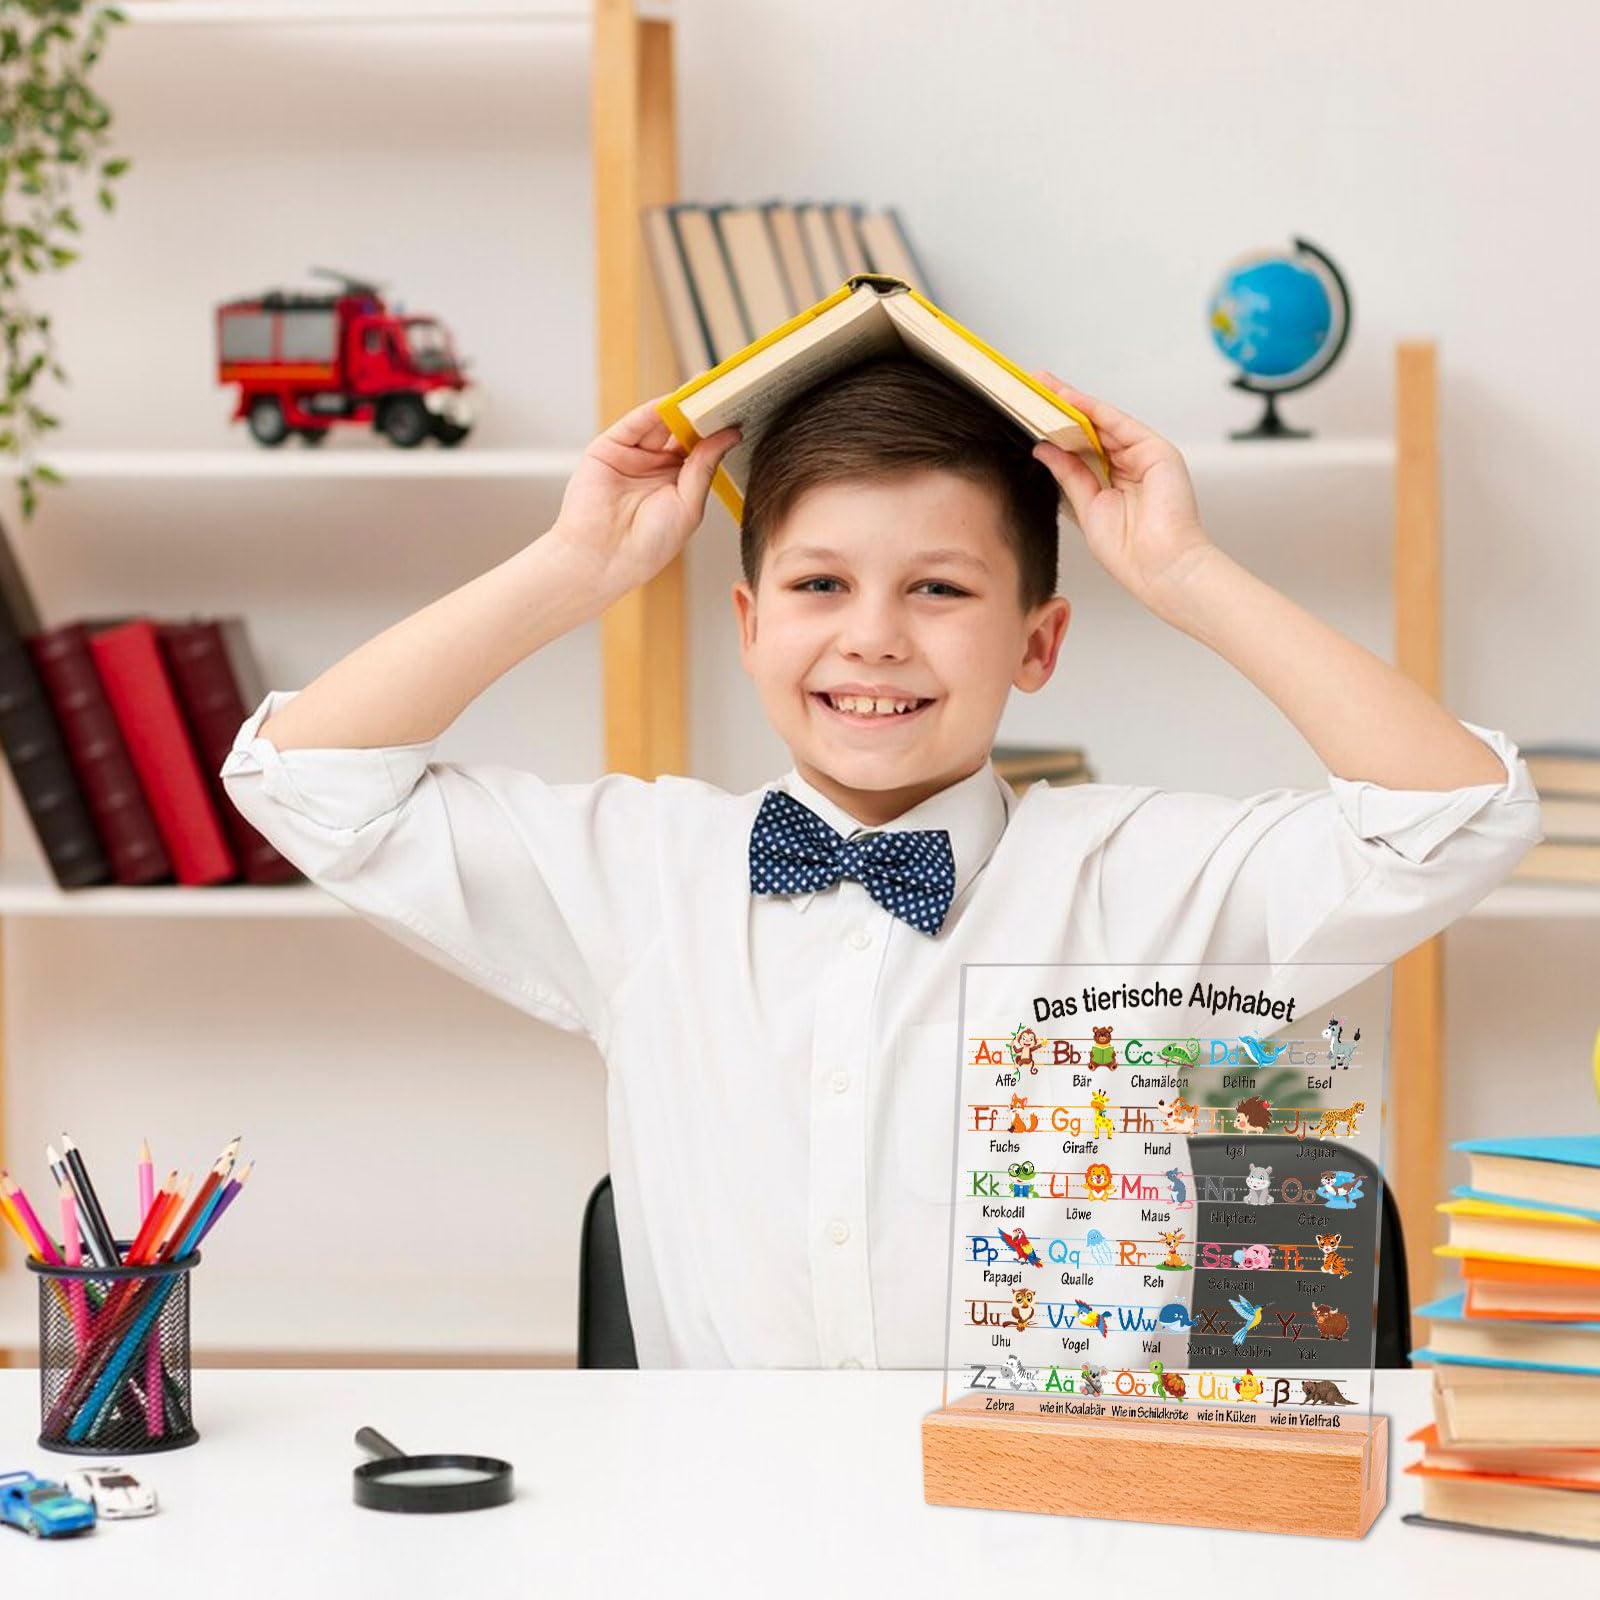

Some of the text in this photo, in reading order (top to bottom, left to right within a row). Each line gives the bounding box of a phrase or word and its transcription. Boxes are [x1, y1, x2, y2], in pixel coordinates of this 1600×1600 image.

[1033, 982, 1296, 1022] Das tierische Alphabet
[975, 1040, 1002, 1064] Aa
[1053, 1040, 1081, 1065] Bb
[1124, 1040, 1153, 1064] Cc
[1210, 1039, 1239, 1065] Dd
[1289, 1041, 1316, 1064] Ee
[995, 1074, 1017, 1086] Affe
[1073, 1075, 1092, 1087] Bär
[1131, 1075, 1188, 1088] Chamäleon
[1223, 1076, 1255, 1088] Delfin
[1308, 1076, 1332, 1089] Esel
[974, 1107, 998, 1130] Ff
[1051, 1107, 1081, 1137] Gg
[1124, 1108, 1154, 1132] Hh
[1283, 1111, 1306, 1141] Jj
[990, 1140, 1020, 1152] Fuchs
[1063, 1140, 1098, 1154] Giraffe
[1144, 1142, 1171, 1155] Hund
[1226, 1145, 1246, 1159] Igel
[1296, 1145, 1336, 1160] Jaguar
[973, 1172, 1000, 1195] Kk
[1122, 1175, 1158, 1199] Mm
[1205, 1176, 1235, 1201] Nn
[1282, 1177, 1316, 1203] Oo
[983, 1205, 1024, 1218] Krokodil
[1067, 1208, 1091, 1219] Löwe
[1142, 1209, 1170, 1222] Maus
[972, 1237, 998, 1266] Pp
[1048, 1240, 1080, 1269] Qq
[1120, 1241, 1147, 1265] Rr
[1202, 1243, 1232, 1268] Ss
[1279, 1246, 1303, 1271] Tt
[983, 1270, 1022, 1286] Papagei
[1061, 1273, 1093, 1286] Qualle
[1144, 1275, 1164, 1288] Reh
[1208, 1277, 1255, 1291] Schwein
[1295, 1280, 1326, 1296] Tiger
[971, 1302, 1000, 1325] Uu
[1048, 1304, 1074, 1328] Vv
[1118, 1307, 1157, 1331] Ww
[1201, 1310, 1229, 1334] Xx
[1276, 1312, 1302, 1342] Yy
[992, 1334, 1011, 1347] Uhu
[1062, 1338, 1089, 1352] Vogel
[1143, 1341, 1160, 1353] Wal
[1298, 1347, 1317, 1359] Yak
[970, 1365, 996, 1389] Zz
[1046, 1365, 1074, 1392] Ää
[1116, 1368, 1146, 1395] Öö
[1198, 1372, 1228, 1400] Üü
[985, 1398, 1014, 1411] Zebra
[1065, 1403, 1106, 1416] Koalabär
[1137, 1407, 1188, 1421] Schildkröte
[1198, 1410, 1256, 1423] wie in Küken
[1270, 1414, 1341, 1428] wie in Vielfraß
